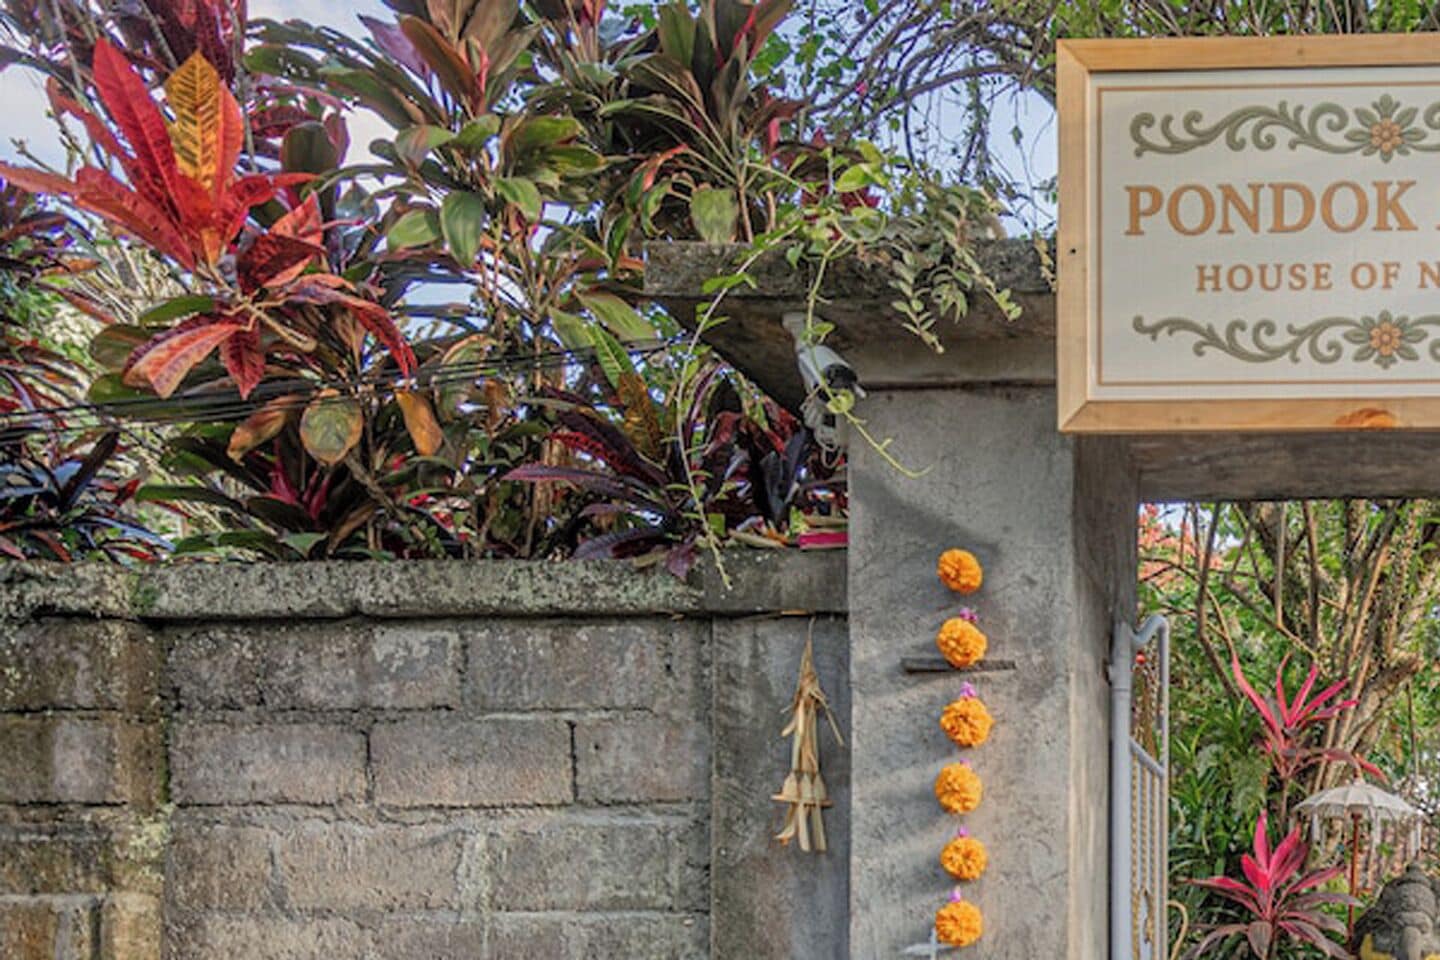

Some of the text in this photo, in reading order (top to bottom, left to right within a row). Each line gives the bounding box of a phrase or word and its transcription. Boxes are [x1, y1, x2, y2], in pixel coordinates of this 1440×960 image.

[1124, 179, 1418, 236] PONDOK
[1196, 263, 1332, 293] HOUSE
[1350, 262, 1403, 291] OF
